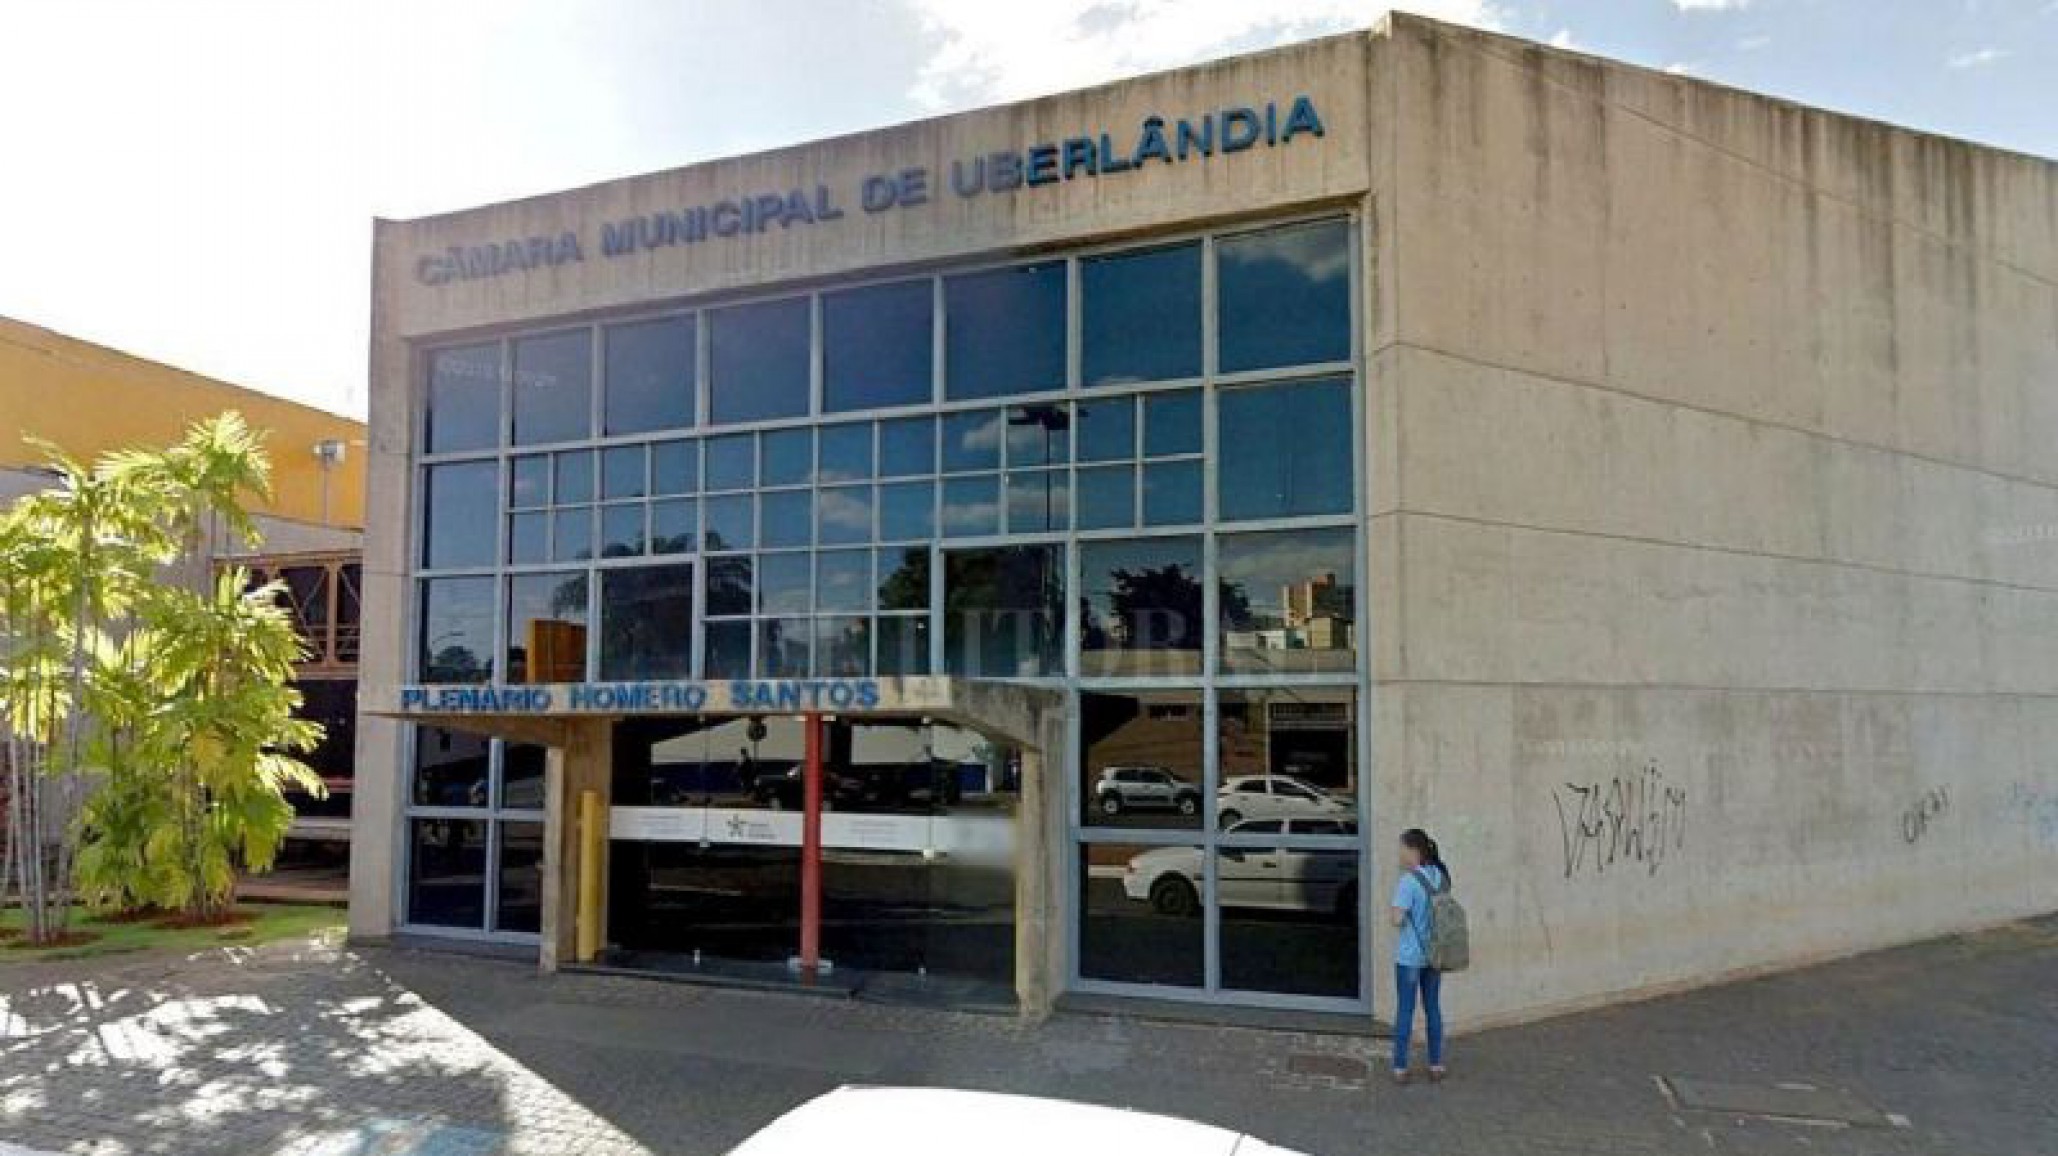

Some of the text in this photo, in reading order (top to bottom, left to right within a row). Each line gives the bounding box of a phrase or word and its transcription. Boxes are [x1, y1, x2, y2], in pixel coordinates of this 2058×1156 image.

[416, 95, 1325, 286] CÂMARA MUNICIPAL DE UBERLÂNDIA
[570, 684, 706, 710] HOMERO
[730, 681, 880, 710] SANTOS
